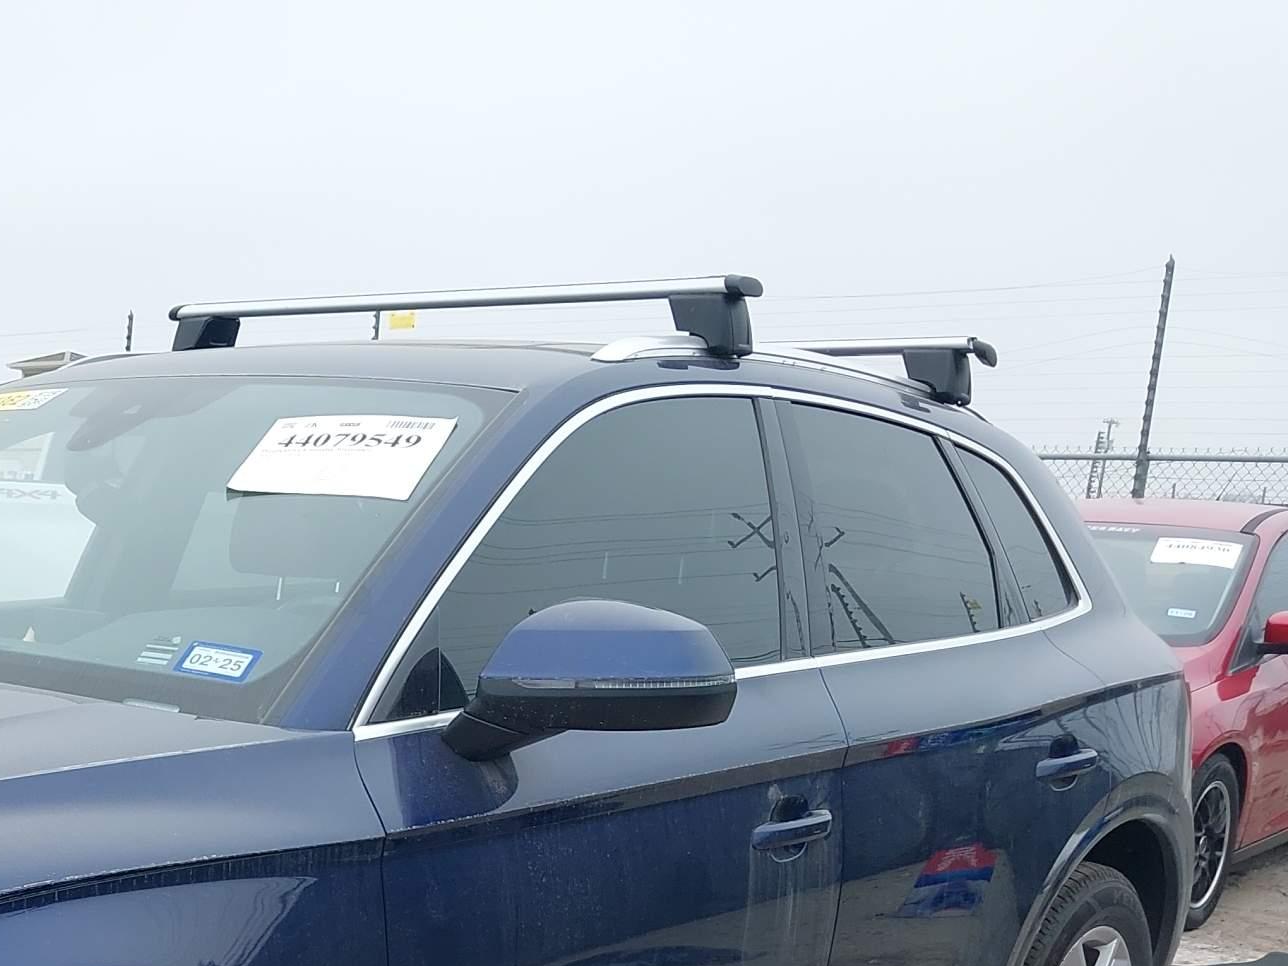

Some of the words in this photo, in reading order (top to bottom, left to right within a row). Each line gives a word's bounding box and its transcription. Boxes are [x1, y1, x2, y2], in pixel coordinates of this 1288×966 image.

[277, 432, 423, 449] 44079549
[190, 653, 213, 667] 02
[219, 658, 244, 671] 25
